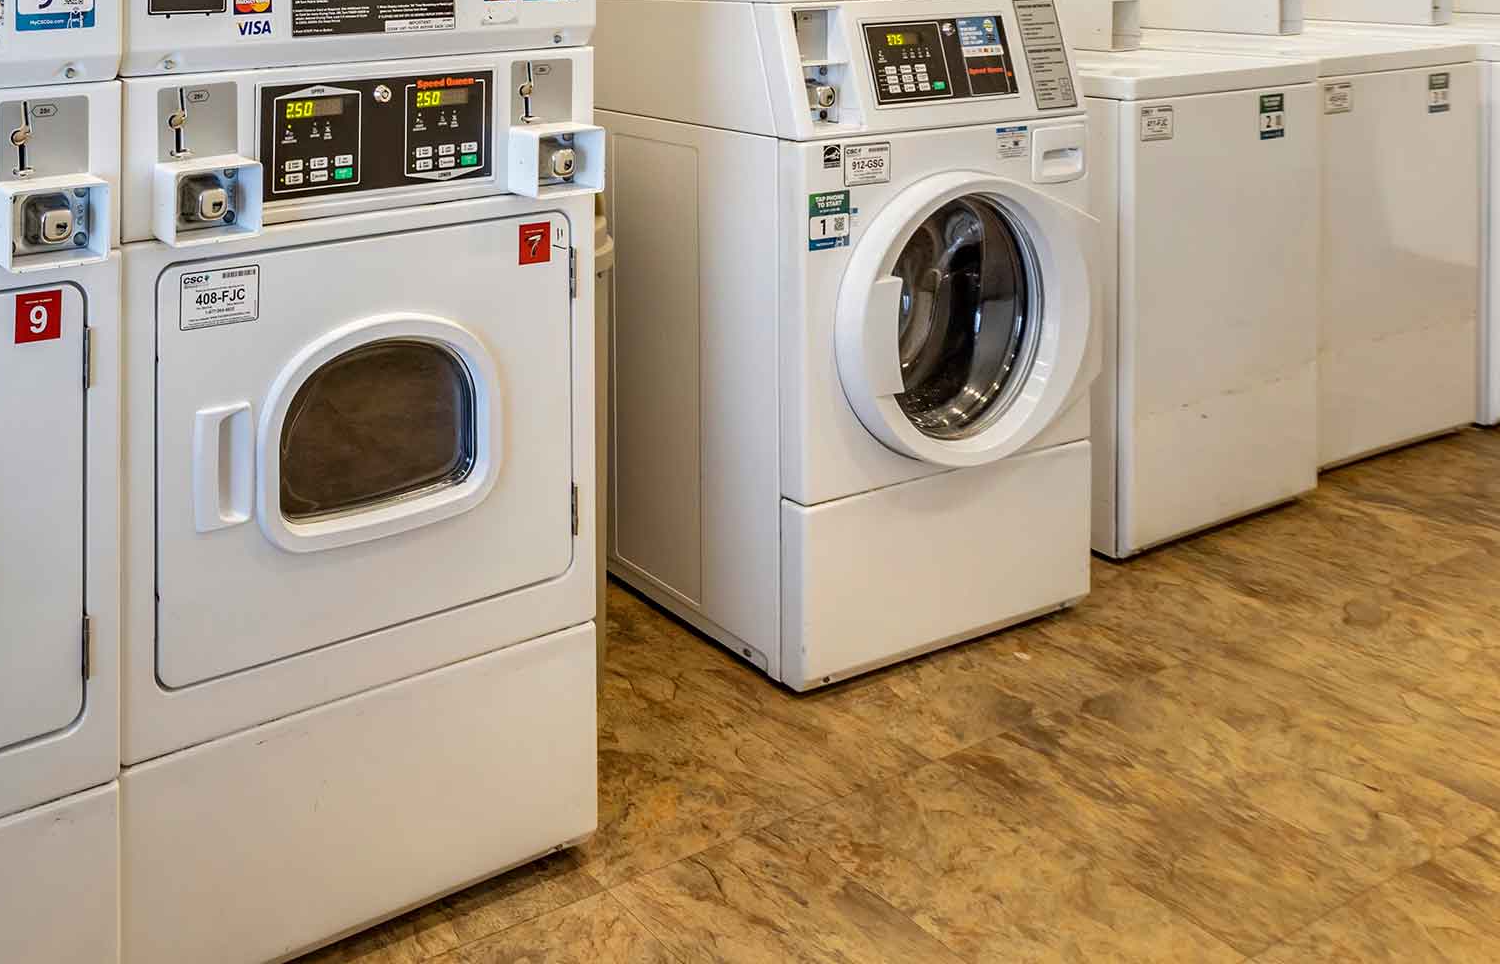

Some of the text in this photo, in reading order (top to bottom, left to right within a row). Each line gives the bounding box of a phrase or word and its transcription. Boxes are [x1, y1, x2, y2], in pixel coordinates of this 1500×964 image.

[237, 20, 271, 36] VISA
[286, 101, 314, 119] 2.50
[820, 219, 826, 236] 1
[528, 234, 542, 258] 7
[183, 275, 204, 285] CSC
[195, 288, 246, 306] 408-FJC
[30, 305, 48, 334] 9
